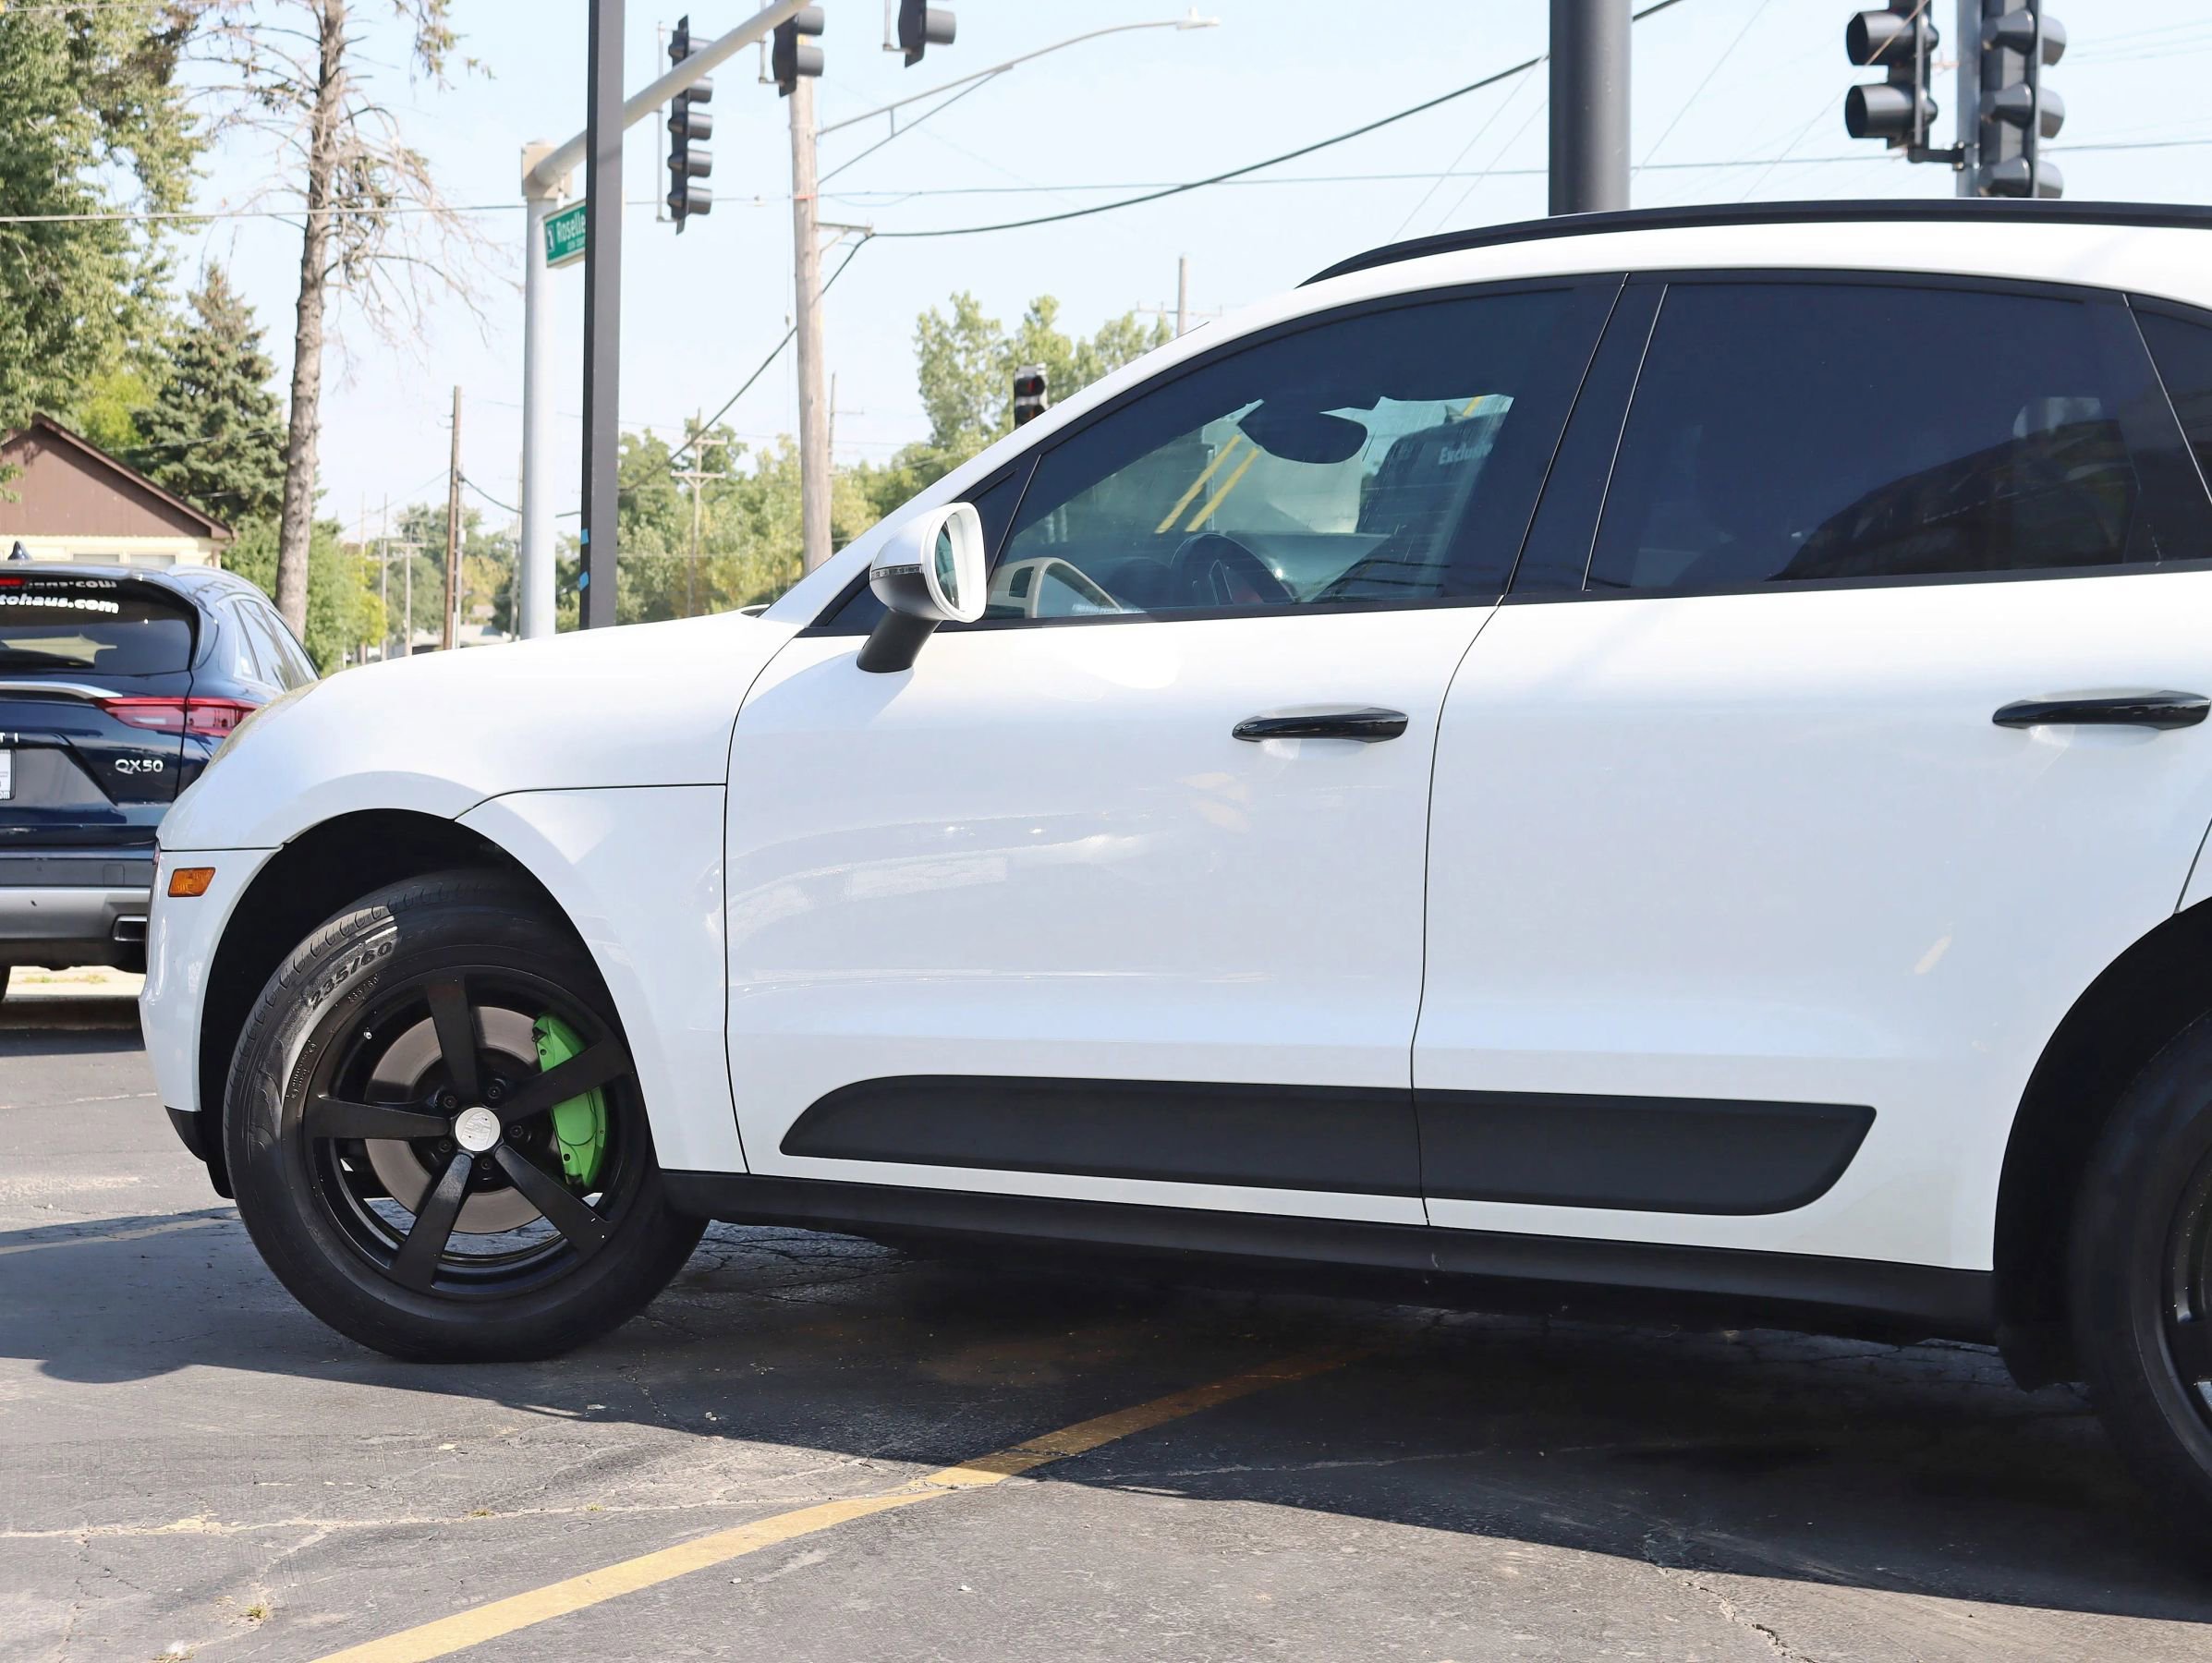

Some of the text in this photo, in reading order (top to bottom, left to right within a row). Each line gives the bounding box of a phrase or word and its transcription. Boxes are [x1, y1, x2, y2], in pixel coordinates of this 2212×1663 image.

[556, 211, 586, 244] Roselle
[0, 593, 119, 613] tohaus.com
[115, 759, 164, 775] QX50
[310, 941, 393, 1010] 235/60
